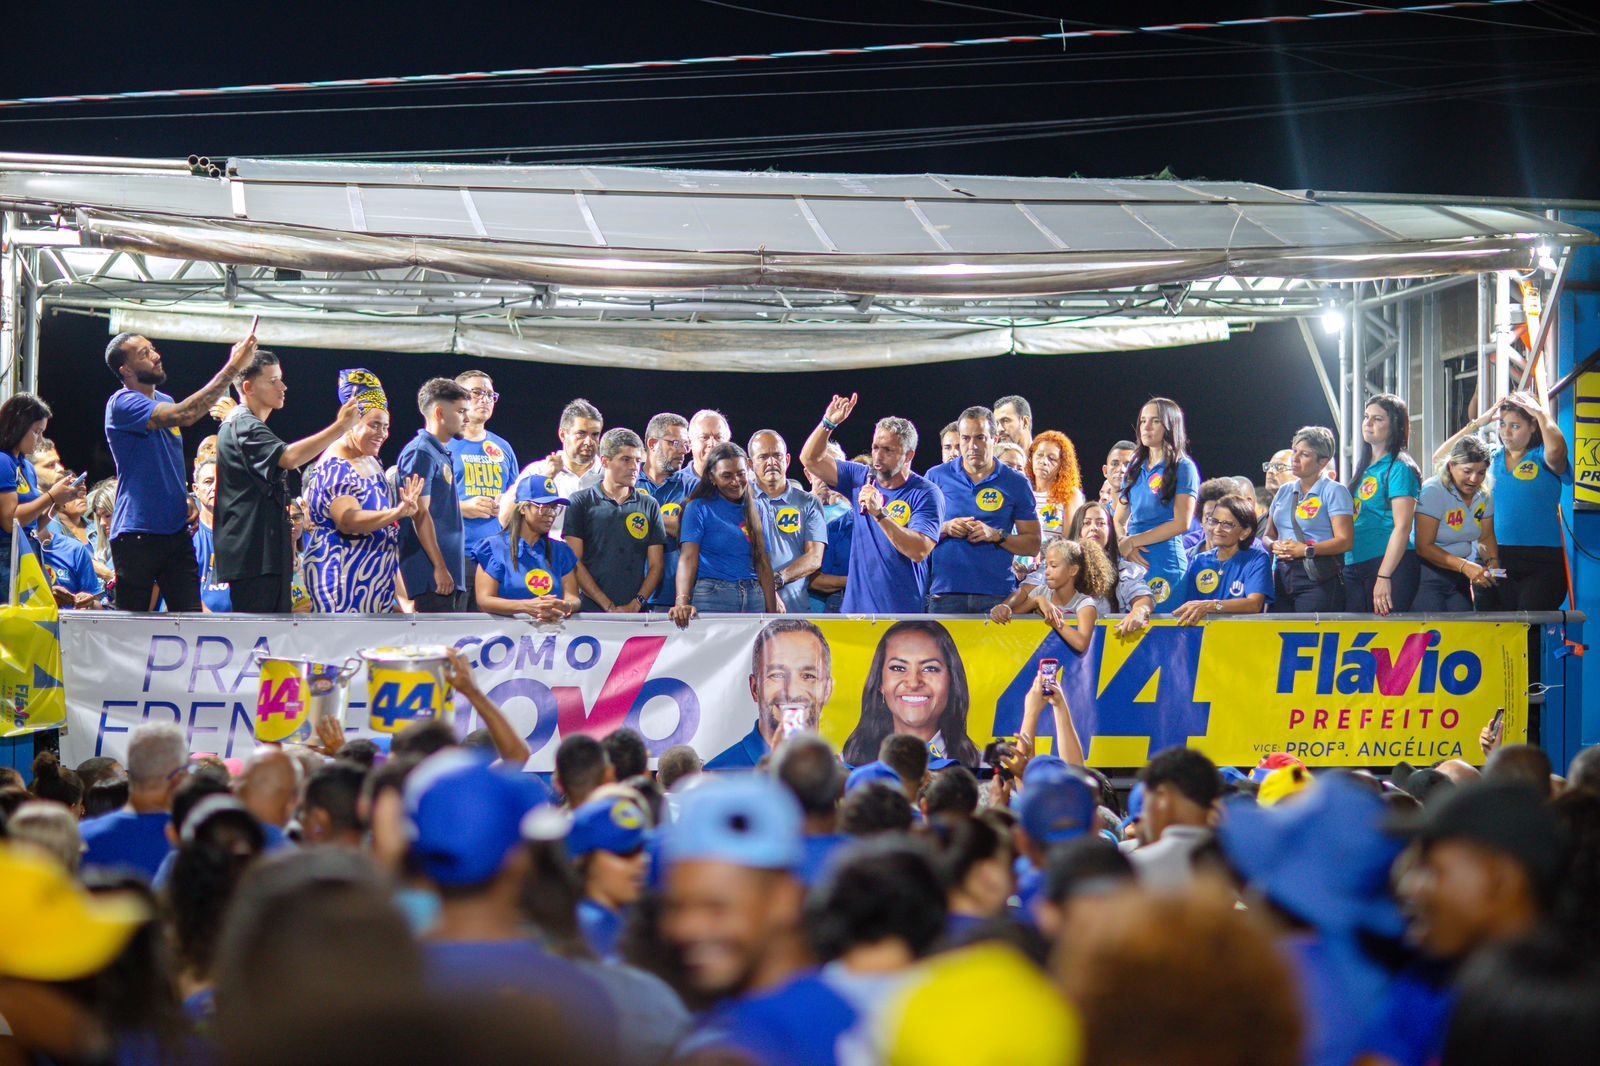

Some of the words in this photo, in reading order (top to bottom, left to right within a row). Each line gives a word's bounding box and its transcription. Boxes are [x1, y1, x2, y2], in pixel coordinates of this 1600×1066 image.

[465, 463, 503, 489] DEUS
[982, 491, 998, 501] 44
[778, 513, 799, 527] 44
[892, 504, 906, 515] 44
[1448, 509, 1464, 526] 44
[528, 575, 551, 591] 44
[142, 634, 272, 693] PRA
[566, 635, 602, 671] O
[1276, 629, 1482, 696] Flávio
[256, 677, 304, 722] 44
[372, 682, 436, 728] 44
[992, 625, 1212, 762] 44
[1288, 709, 1460, 730] PREFEITO
[1253, 743, 1281, 754] VICE:
[1357, 736, 1463, 757] ANGÉLICA
